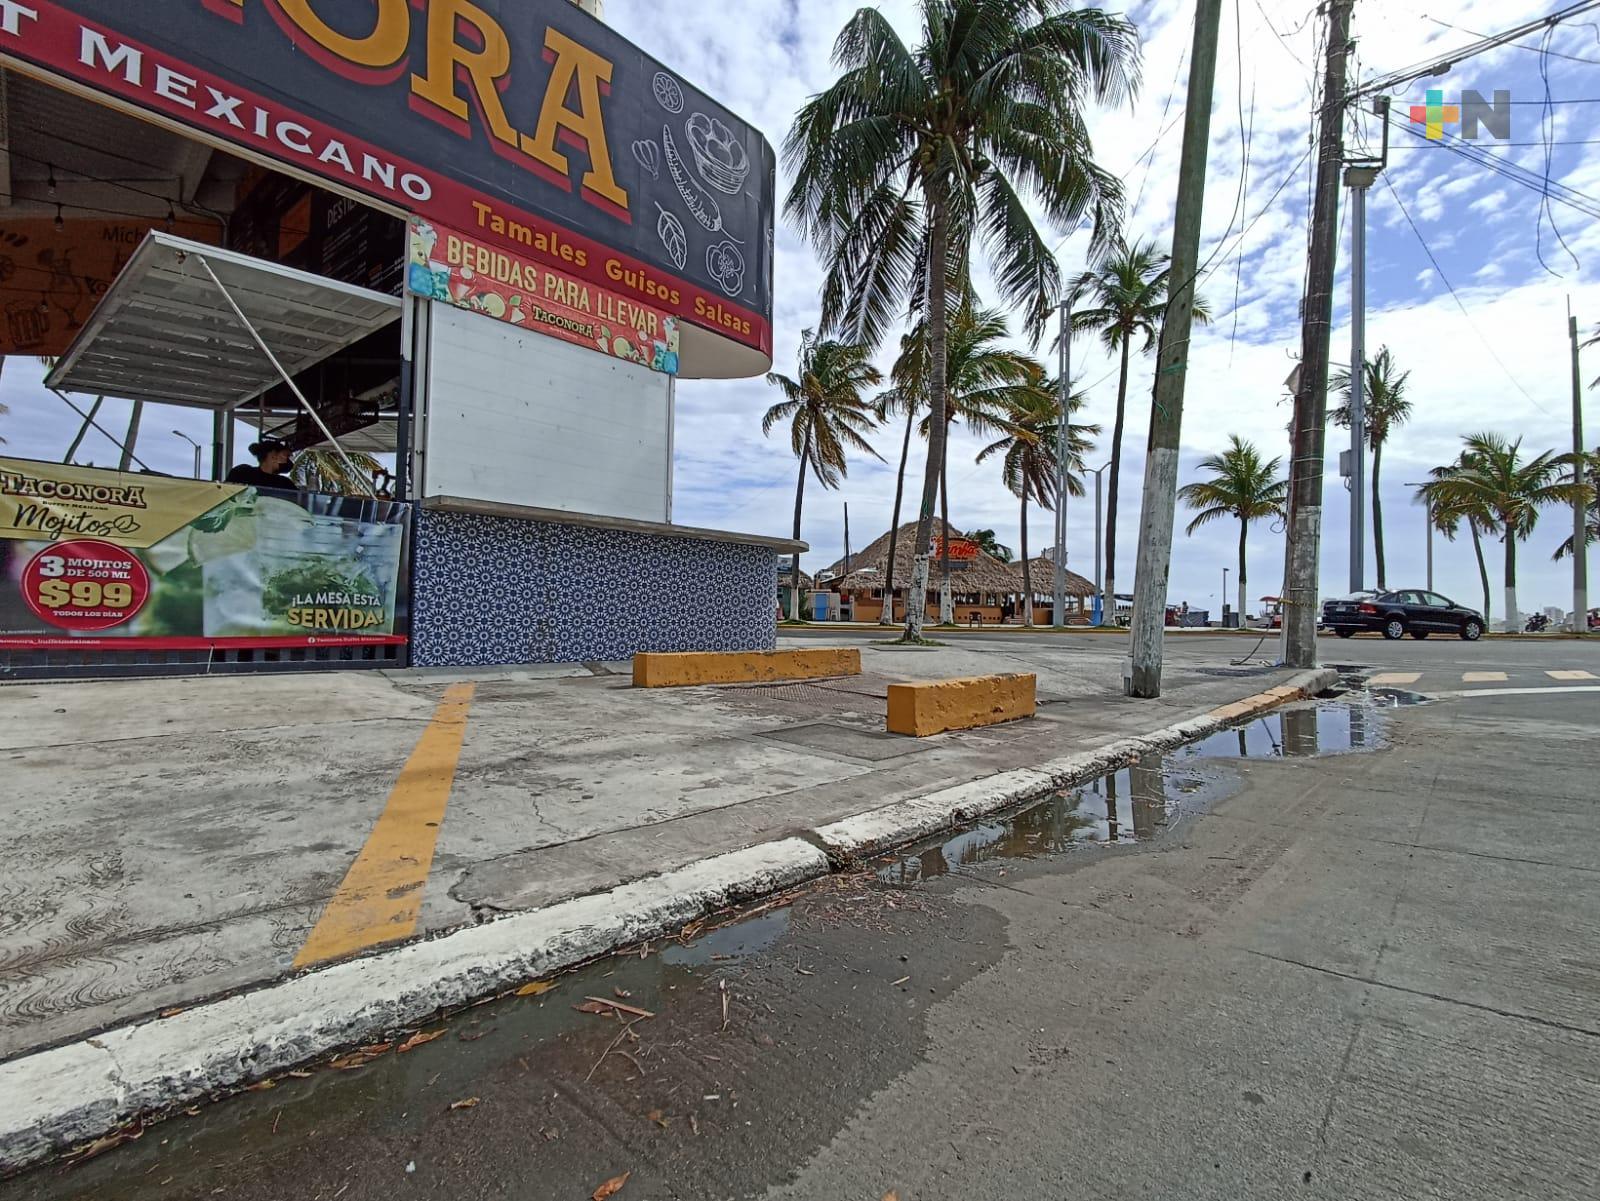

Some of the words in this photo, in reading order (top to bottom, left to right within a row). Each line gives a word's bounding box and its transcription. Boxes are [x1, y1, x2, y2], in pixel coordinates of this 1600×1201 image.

[78, 26, 432, 201] MEXICANO
[226, 0, 629, 210] ORA
[447, 235, 537, 293] BEBIDAS
[544, 272, 590, 313] PARA
[597, 293, 659, 337] LLEVAR
[472, 201, 588, 268] Tamales
[605, 259, 681, 306] Guisos
[694, 297, 751, 336] Salsas
[532, 305, 594, 339] TACONORA
[1, 471, 147, 509] TACONORA
[13, 503, 115, 540] Mojitos
[40, 555, 65, 577] 3
[67, 558, 132, 570] MOJITOS
[67, 568, 85, 577] DE
[87, 570, 109, 578] 500
[111, 571, 131, 579] ML
[39, 578, 132, 608] $99
[316, 591, 351, 605] MESA
[288, 607, 385, 629] SERVIDA!
